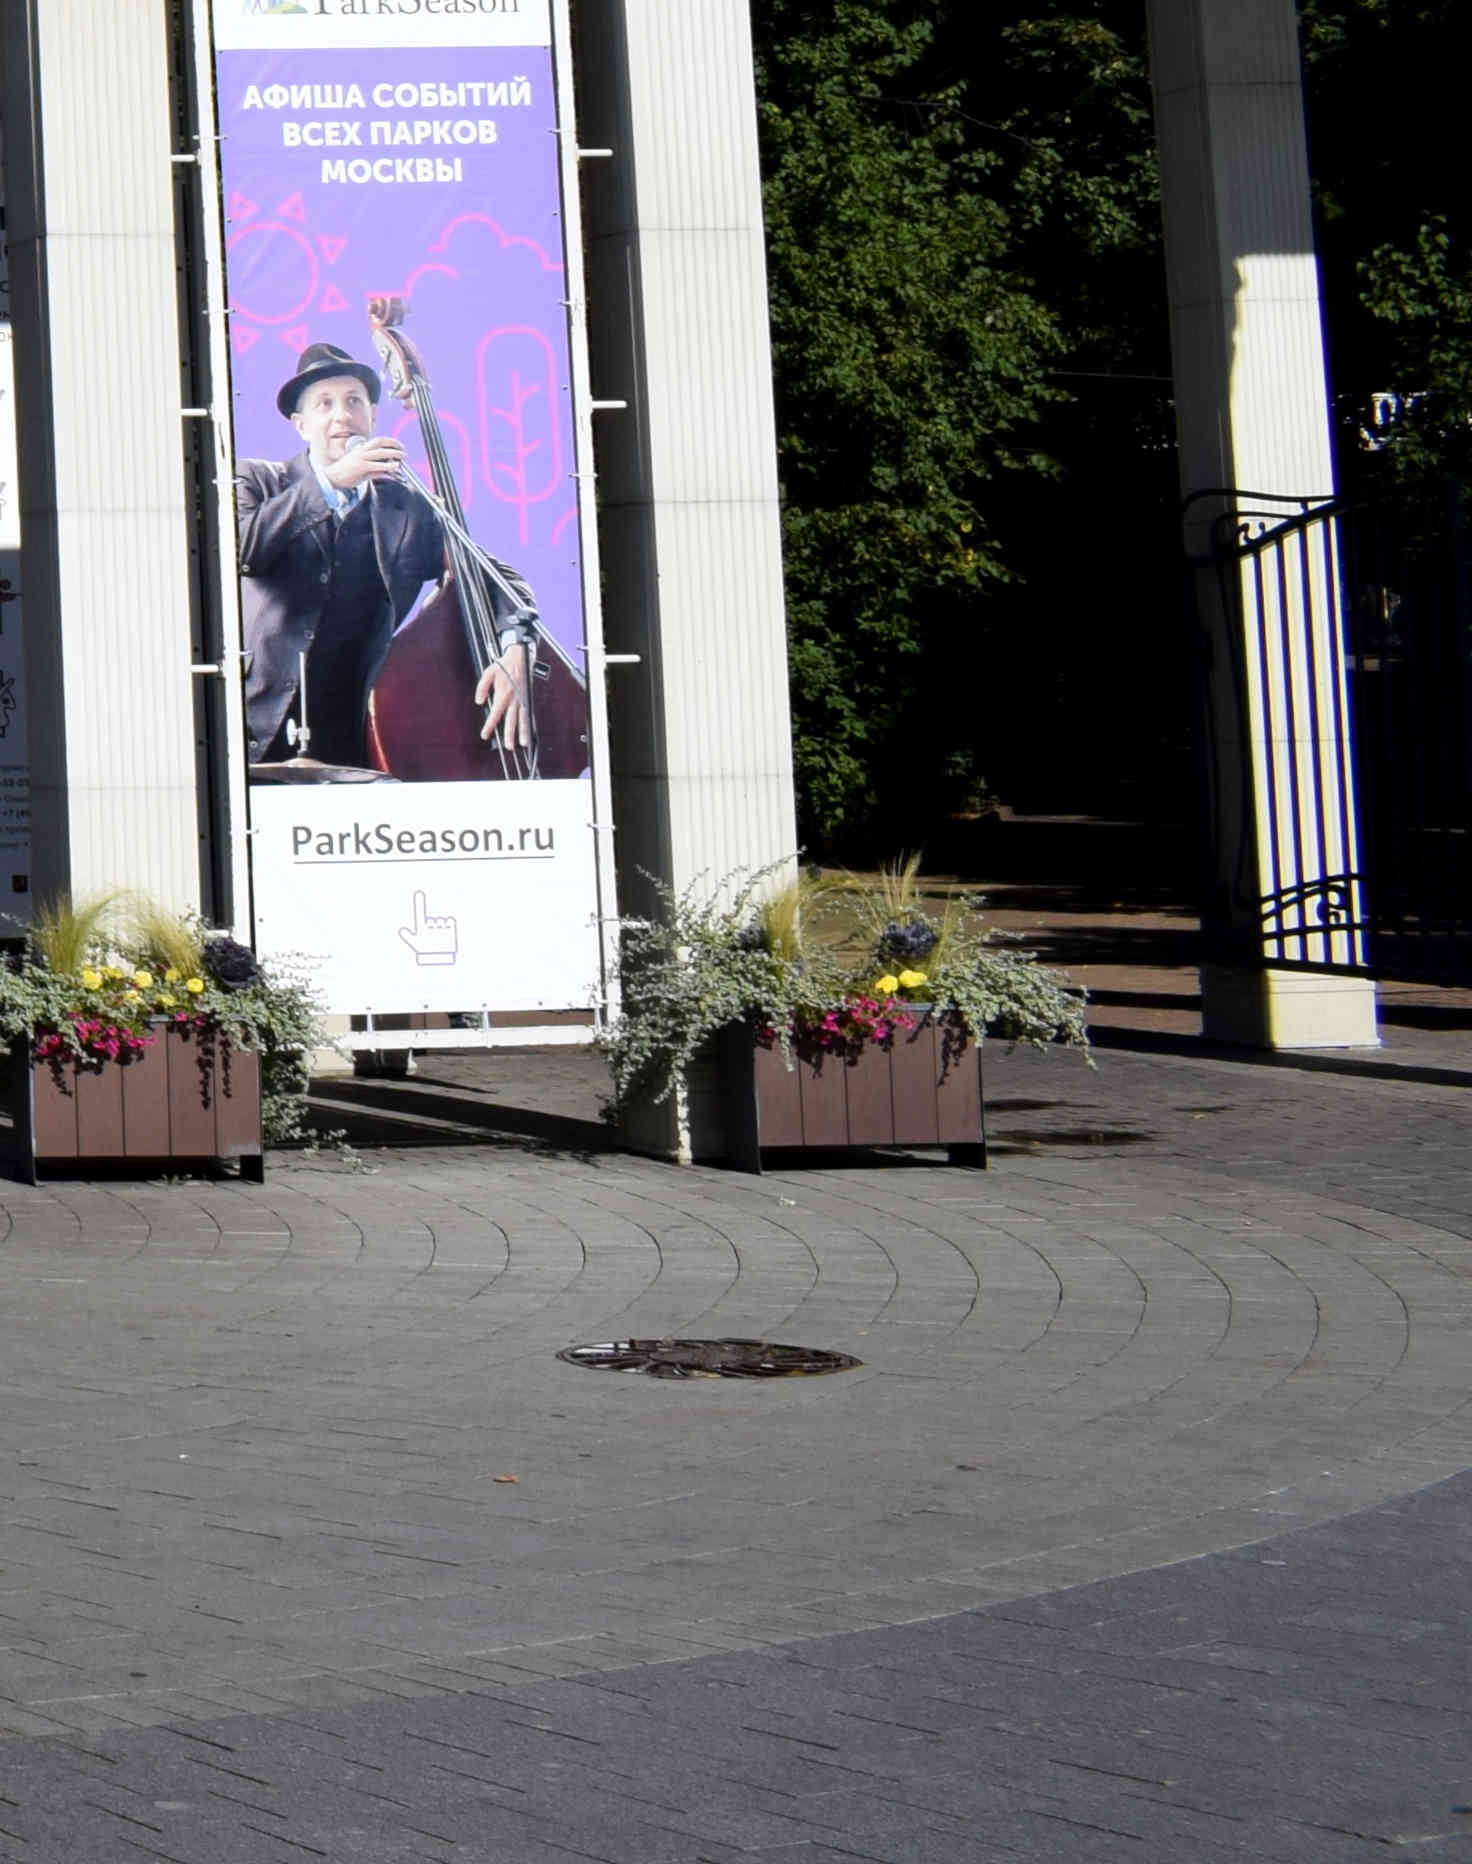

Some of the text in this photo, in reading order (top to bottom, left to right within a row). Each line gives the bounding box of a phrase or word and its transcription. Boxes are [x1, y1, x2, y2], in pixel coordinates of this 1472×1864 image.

[242, 75, 533, 110] АФИША СОБЫТИЙ
[282, 119, 498, 147] ВСЕХ ПАРКОВ
[321, 157, 464, 185] МОСКВЫ
[292, 822, 555, 856] ParkSeason.ru
